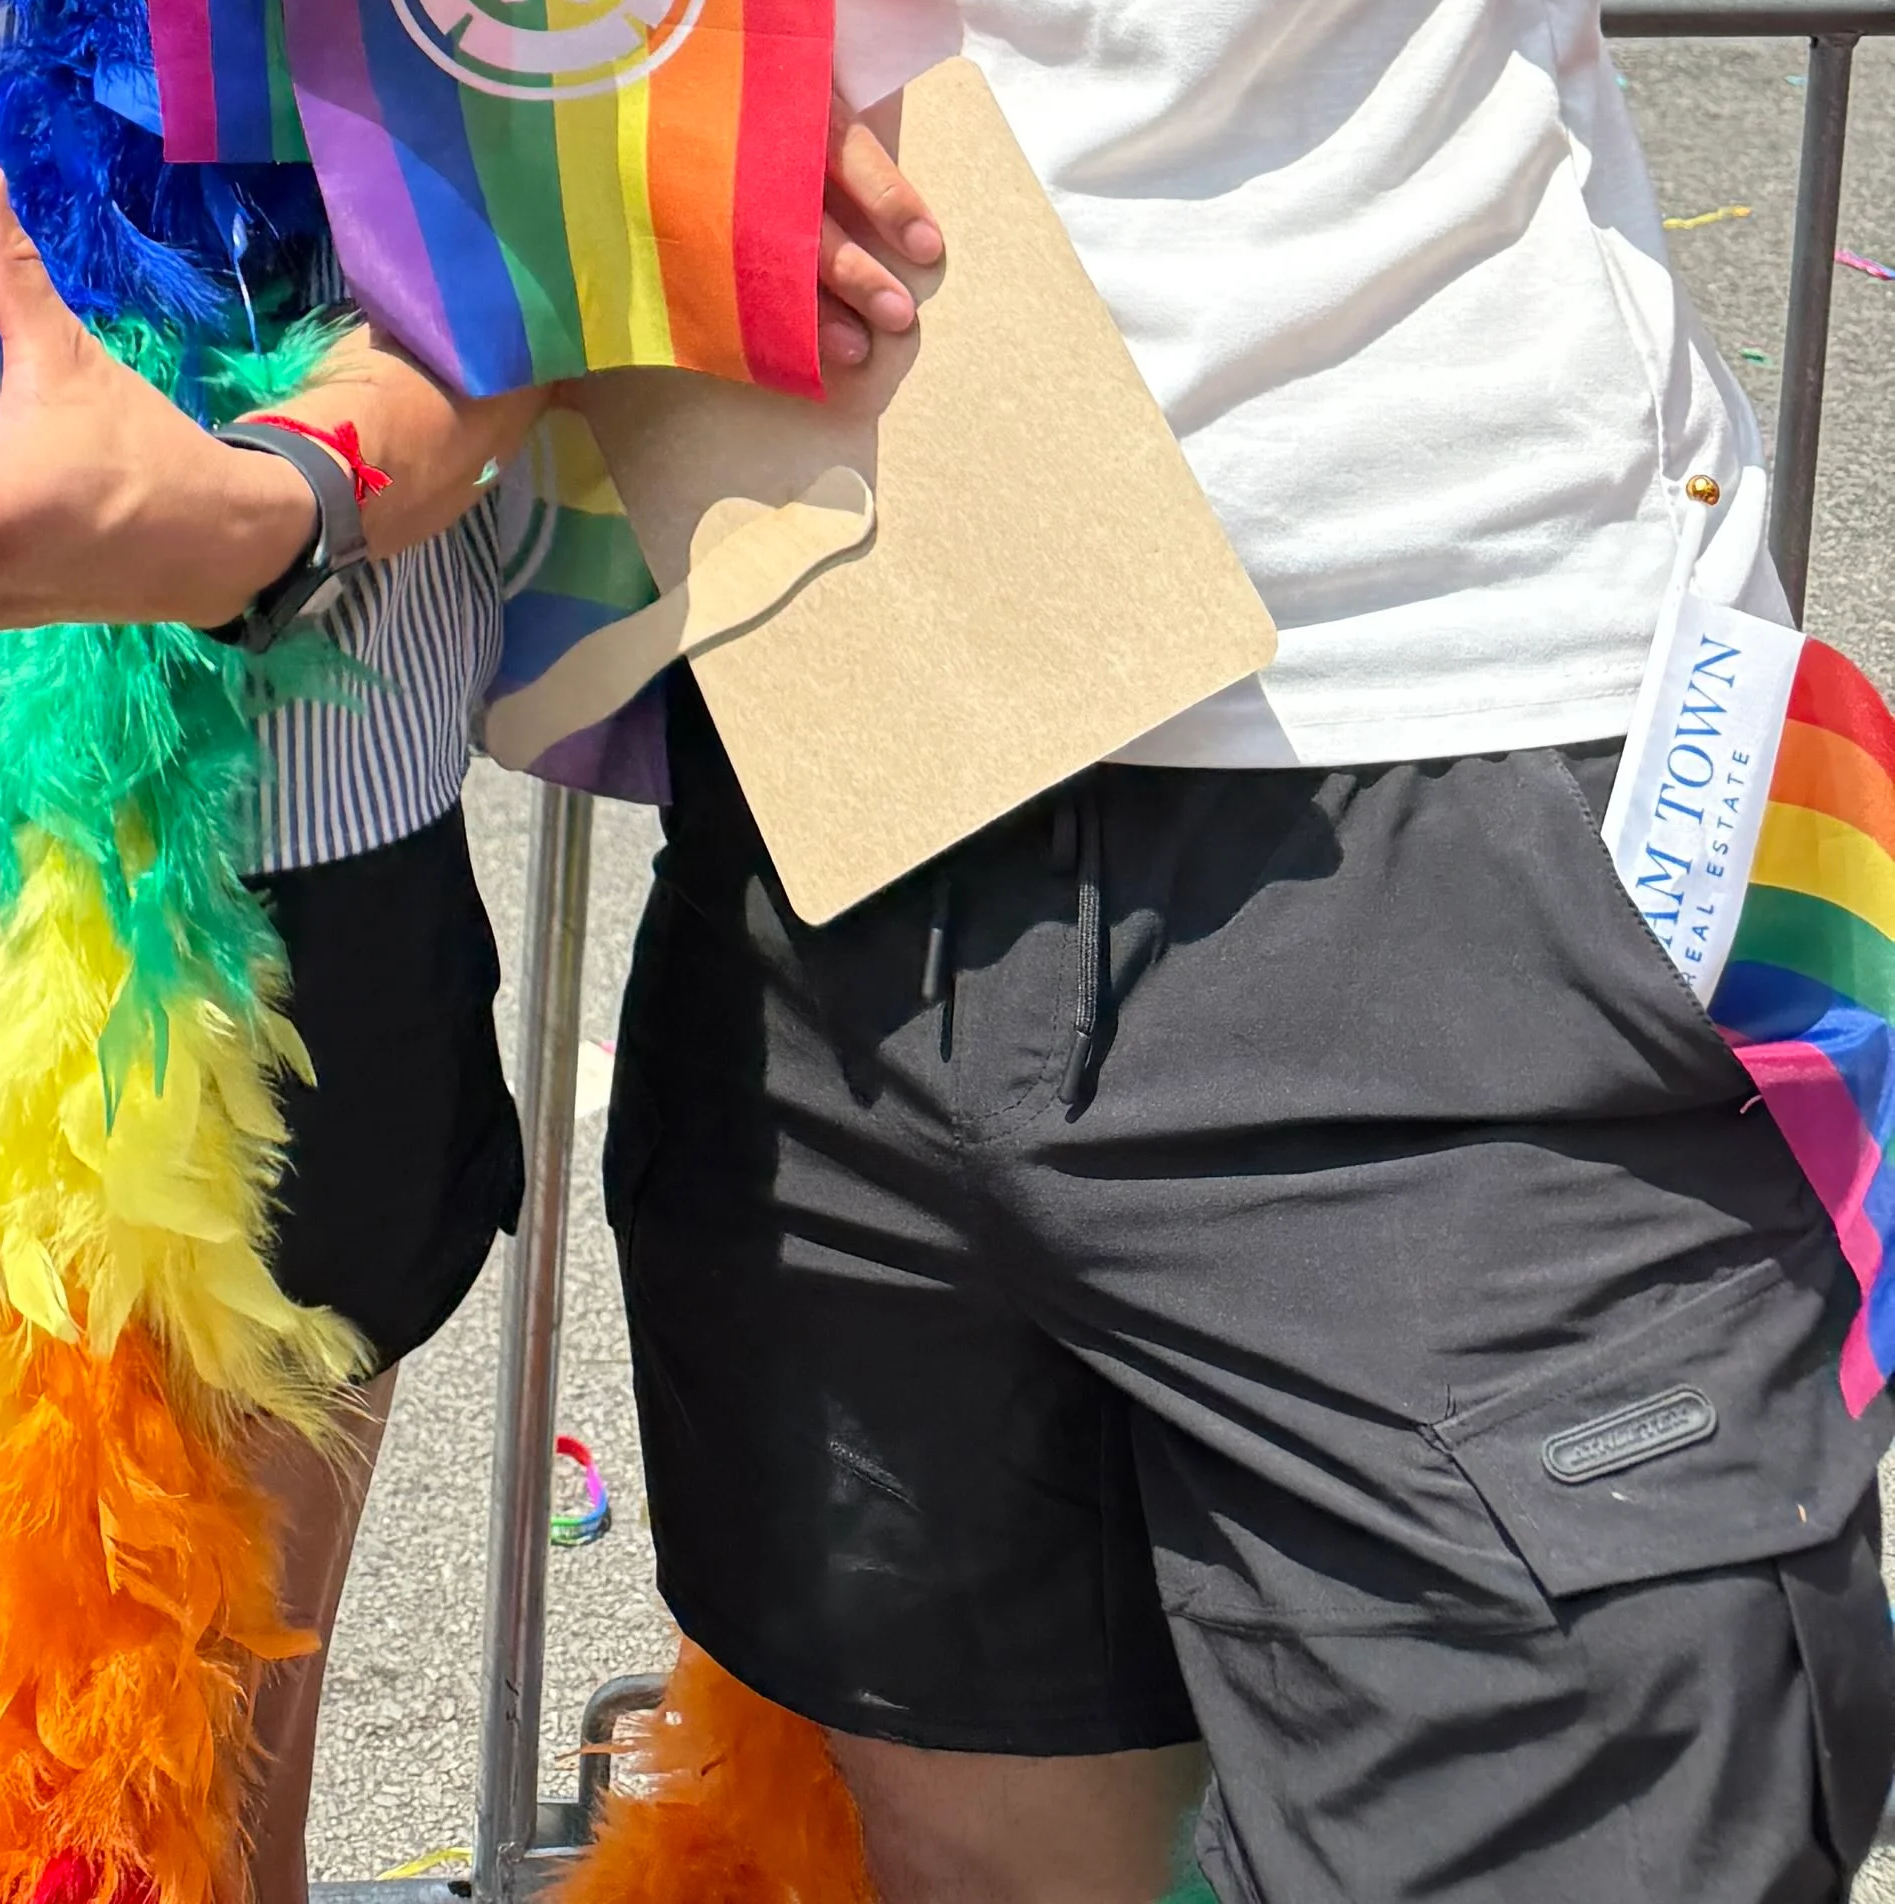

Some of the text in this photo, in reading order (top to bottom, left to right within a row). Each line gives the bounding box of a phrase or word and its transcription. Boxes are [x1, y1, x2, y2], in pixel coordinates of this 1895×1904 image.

[1635, 632, 1744, 949] AM TOWN
[1706, 748, 1751, 880] ESTATE
